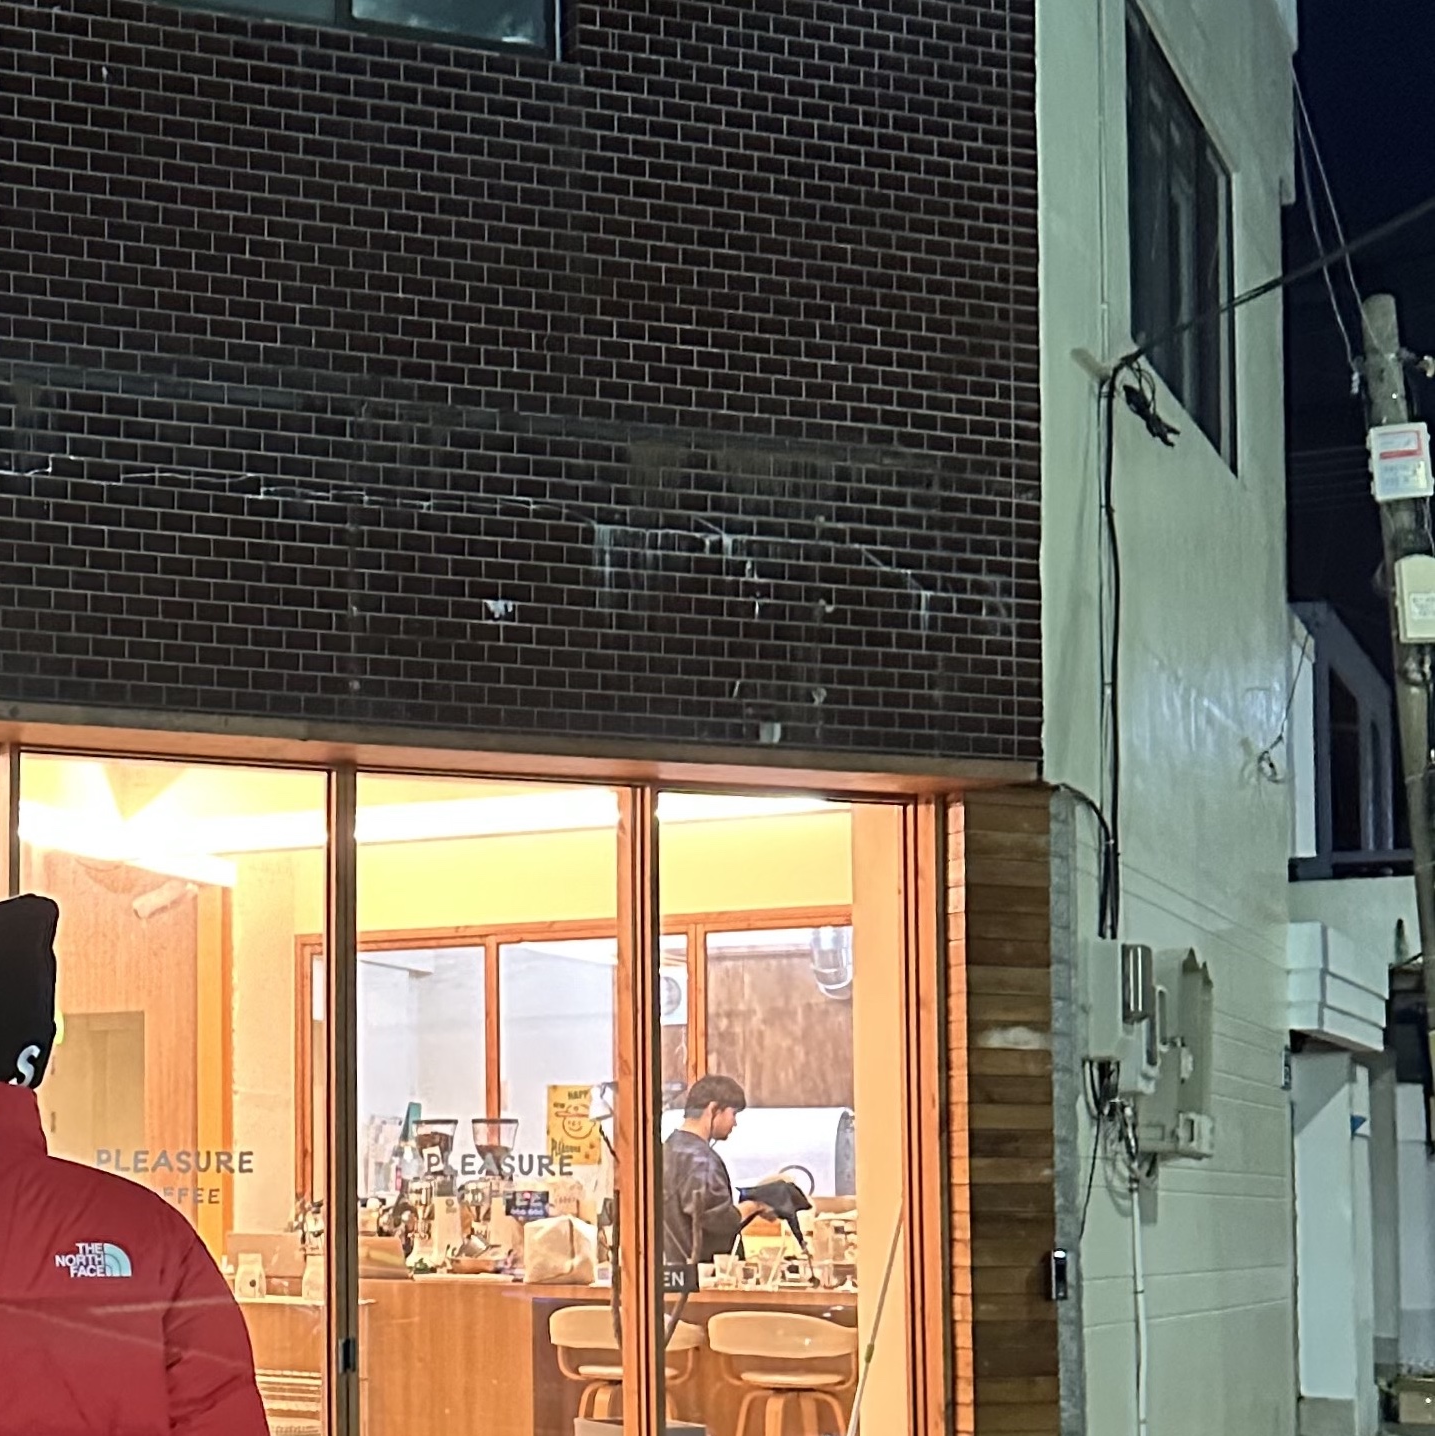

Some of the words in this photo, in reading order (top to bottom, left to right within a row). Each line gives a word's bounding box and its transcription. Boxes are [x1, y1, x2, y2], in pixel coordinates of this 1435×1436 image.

[95, 1148, 255, 1175] PLEASURE
[425, 1153, 574, 1177] PLEASURE
[162, 1187, 221, 1205] FFEE
[75, 1242, 103, 1255] THE
[54, 1254, 104, 1267] NORTH
[70, 1265, 105, 1278] FACE
[663, 1270, 685, 1287] EN
